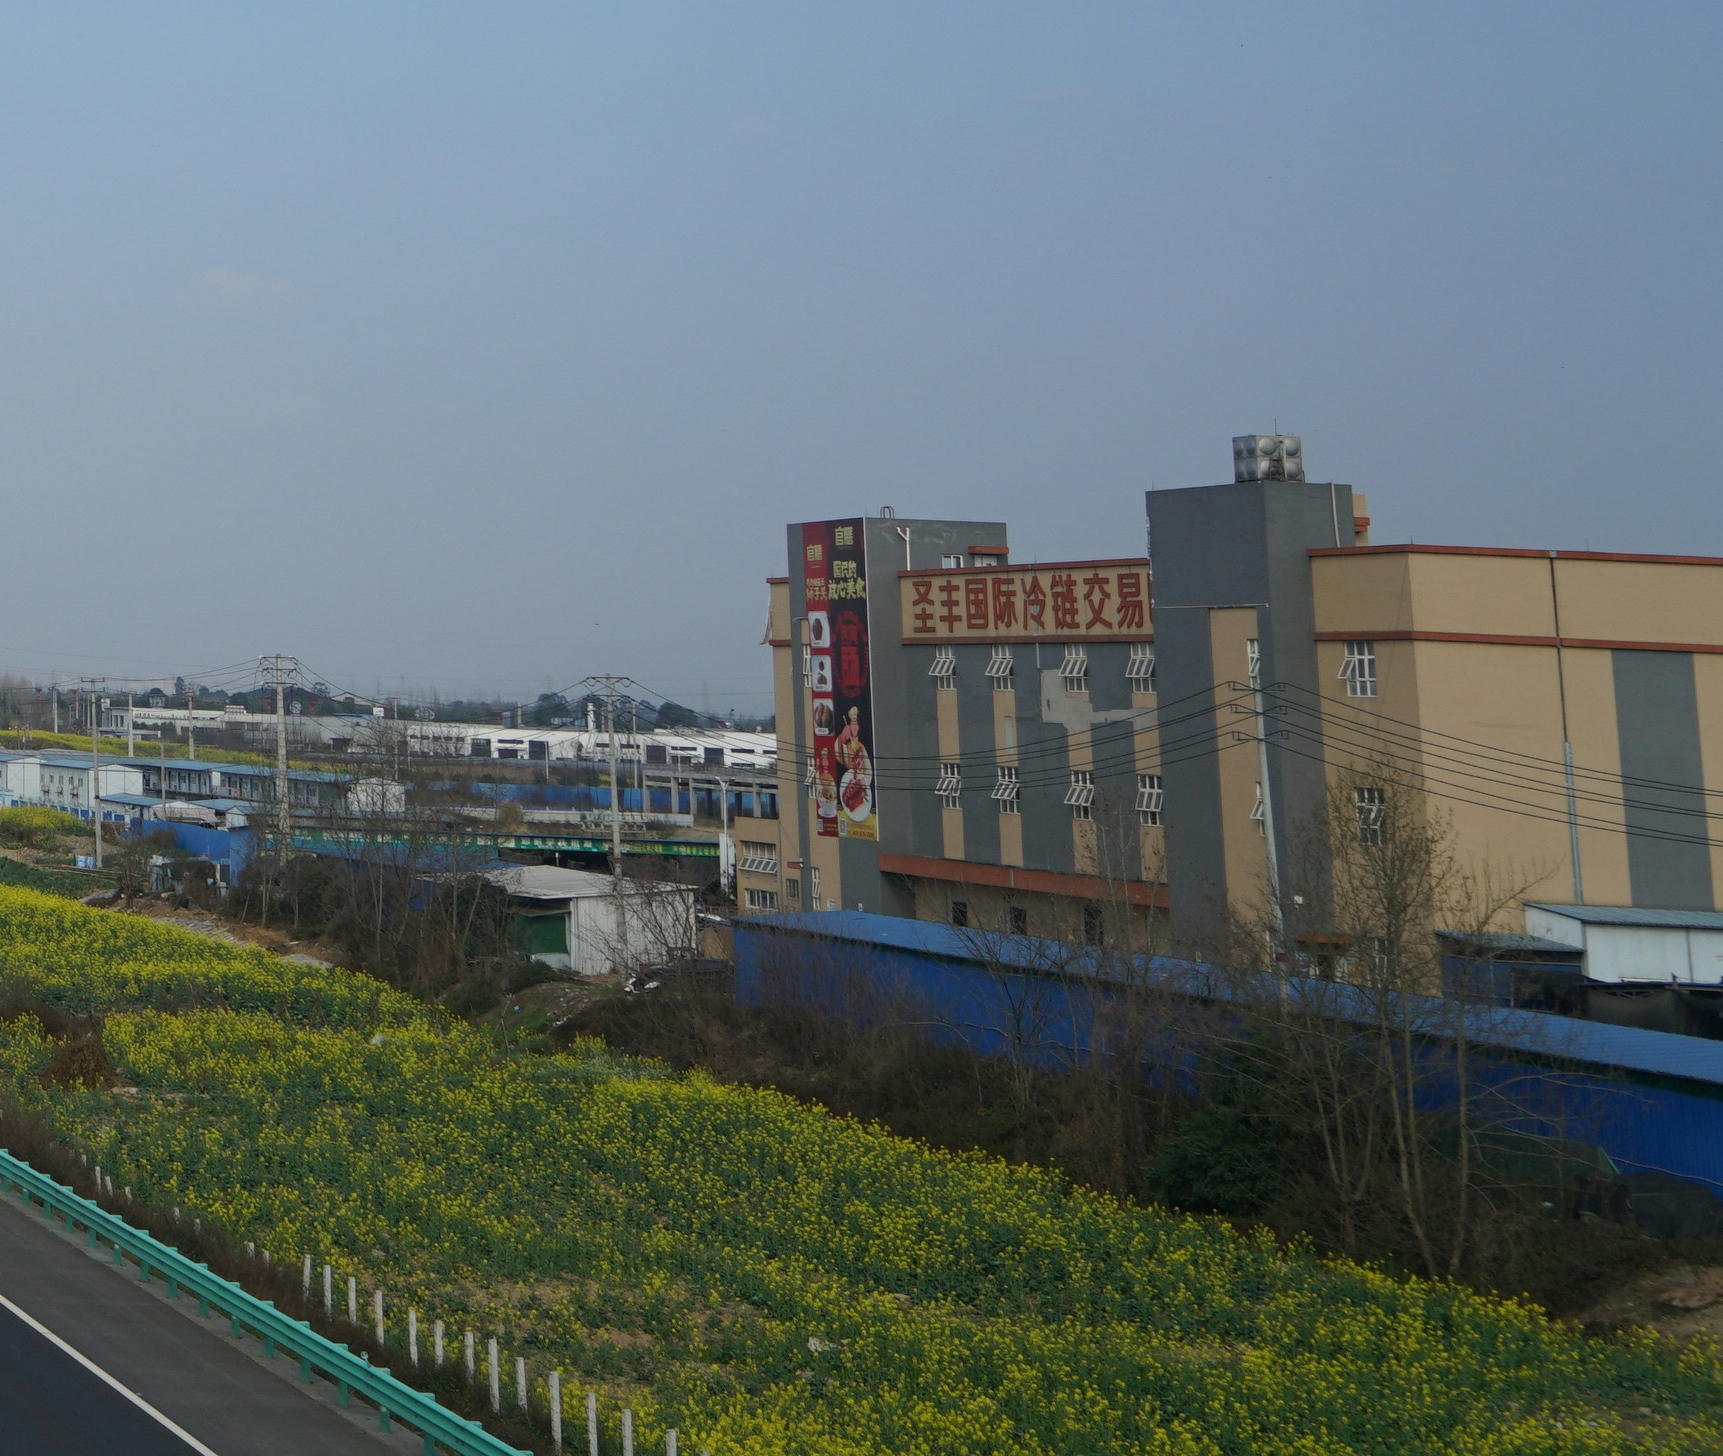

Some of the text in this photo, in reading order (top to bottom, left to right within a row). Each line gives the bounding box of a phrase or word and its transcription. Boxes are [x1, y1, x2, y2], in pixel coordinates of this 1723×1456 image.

[828, 577, 866, 601] 放心美食
[912, 572, 1153, 634] 圣丰国际冷链交易
